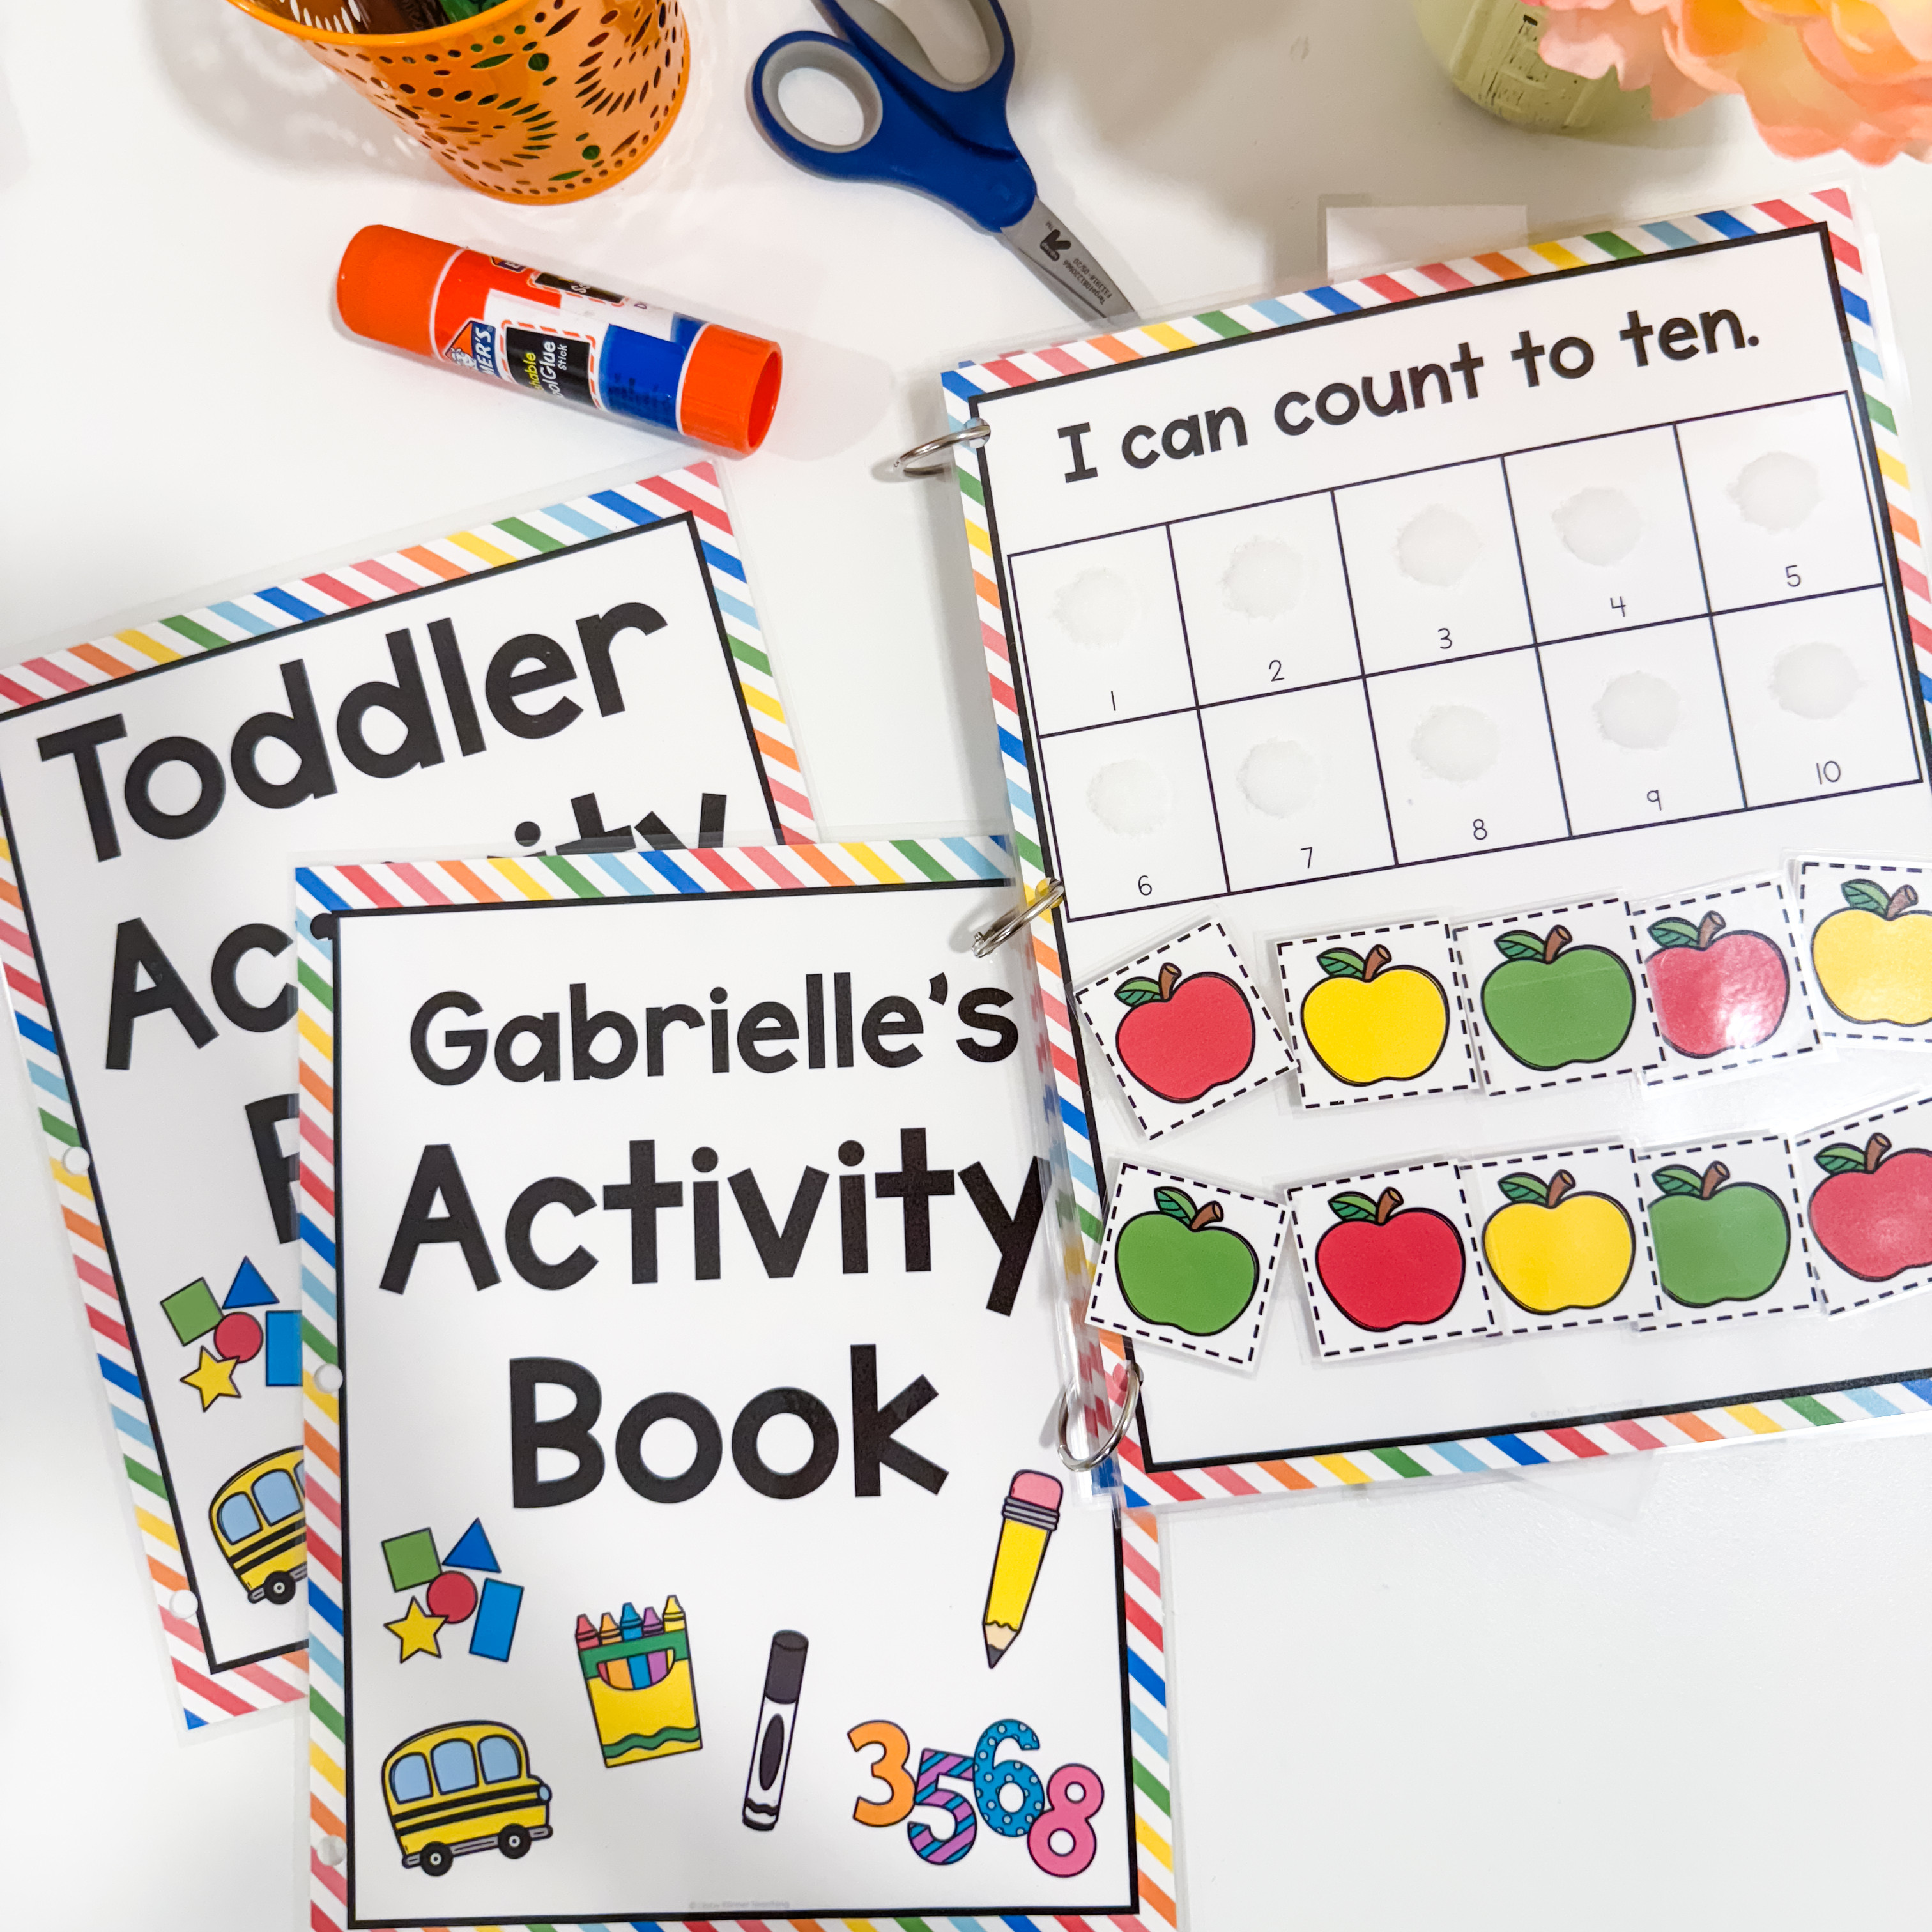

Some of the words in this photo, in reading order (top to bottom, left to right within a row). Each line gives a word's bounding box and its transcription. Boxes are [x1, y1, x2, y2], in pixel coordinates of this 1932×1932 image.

[475, 326, 495, 376] MER'S
[557, 342, 568, 371] Stick
[523, 352, 543, 390] shable
[1058, 422, 1098, 483] I
[1122, 407, 1248, 469] can
[1275, 342, 1484, 436] count
[1511, 331, 1594, 387] to
[1620, 309, 1759, 367] ten.
[1786, 565, 1801, 588] 5
[1610, 596, 1626, 617] 4
[1438, 628, 1452, 650] 3
[1269, 660, 1284, 682] 2
[1110, 690, 1116, 711] 1
[37, 602, 668, 862] Toddler
[1816, 761, 1841, 785] 10
[1647, 790, 1662, 811] 9
[1473, 819, 1487, 840] 8
[1301, 847, 1313, 869] 7
[1138, 875, 1152, 896] 6
[411, 972, 1018, 1085] Gabrielle's
[379, 1128, 1052, 1317] Activity
[510, 1344, 949, 1508] Book
